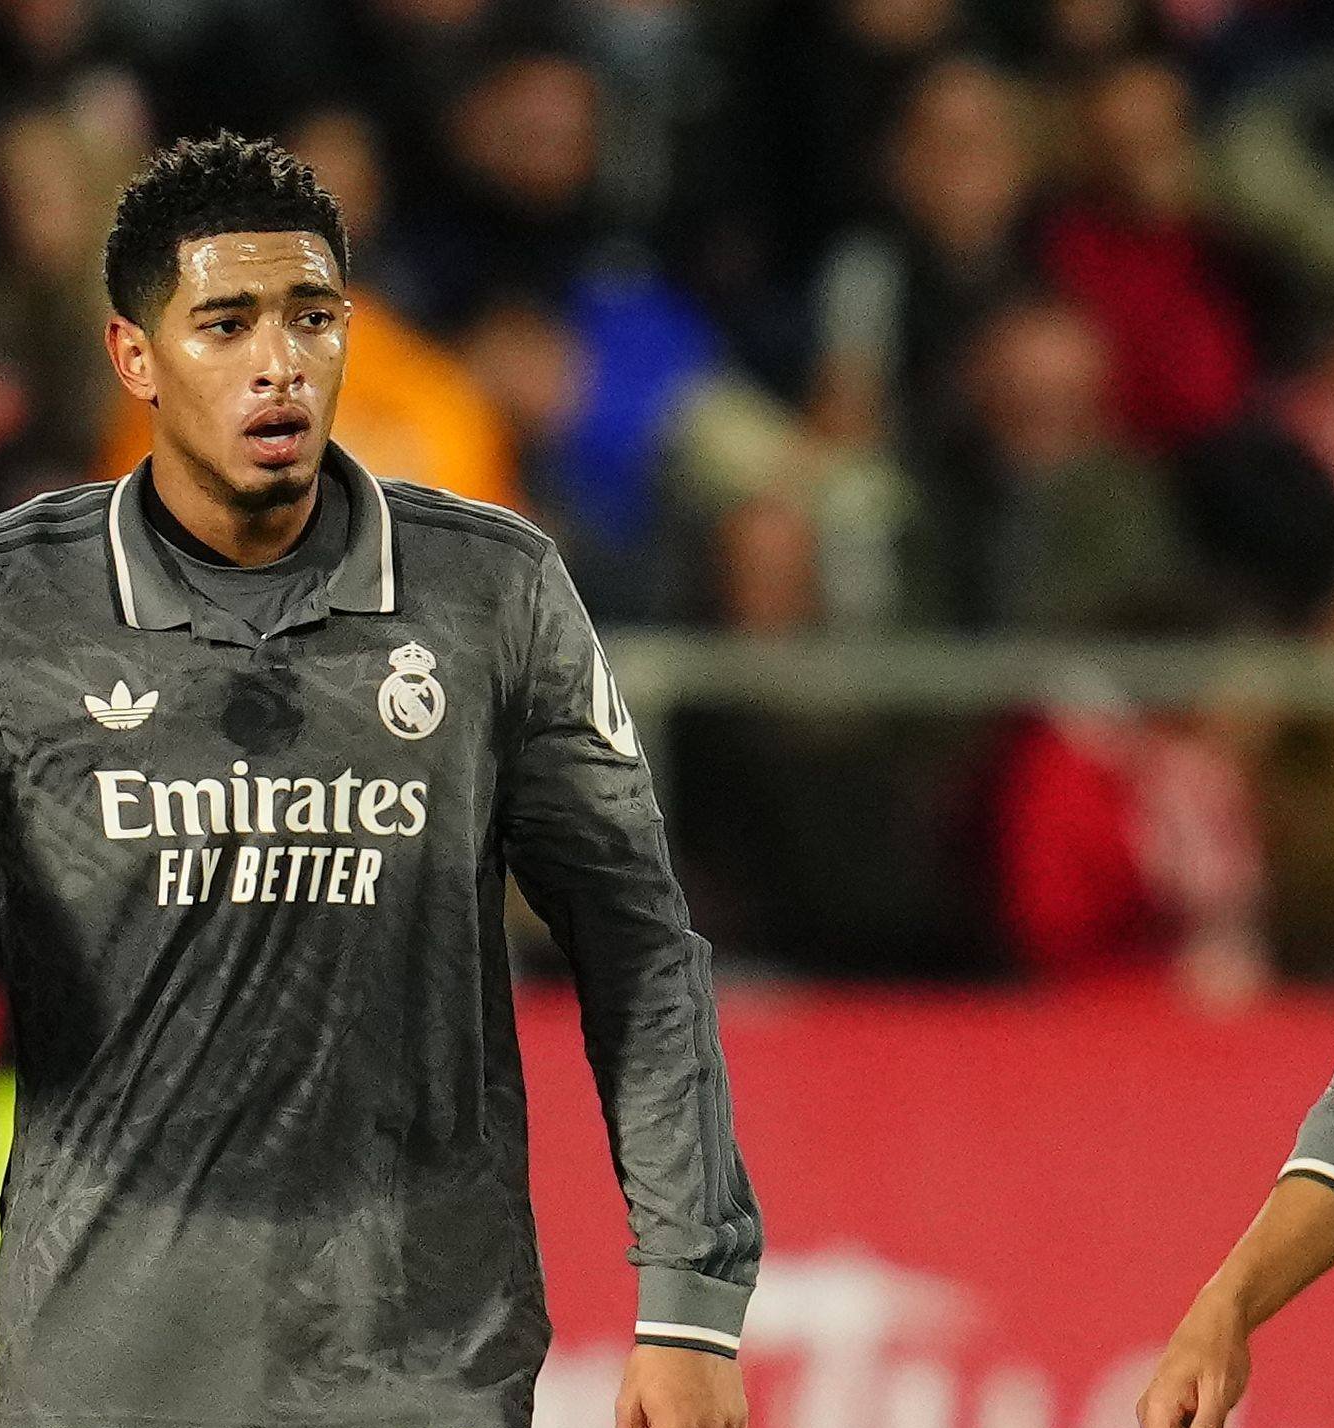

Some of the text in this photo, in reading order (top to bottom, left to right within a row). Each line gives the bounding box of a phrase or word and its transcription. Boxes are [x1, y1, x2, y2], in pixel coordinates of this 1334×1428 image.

[93, 760, 428, 841] Emirates
[156, 845, 384, 906] FLY BETTER
